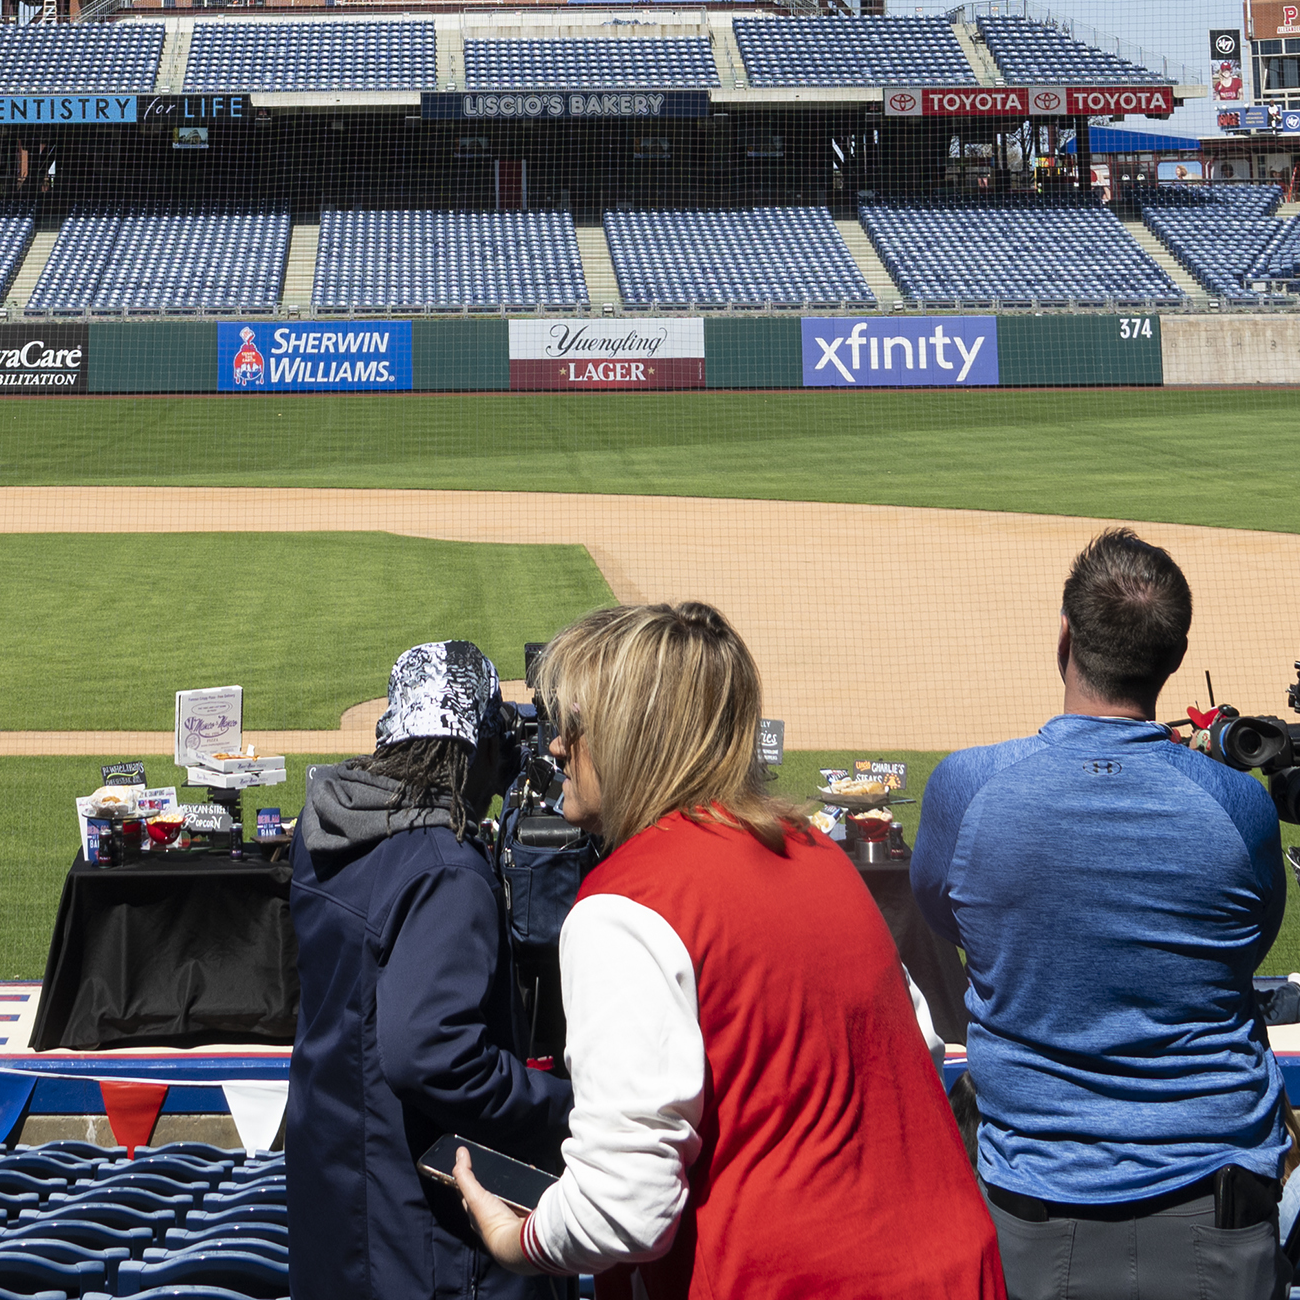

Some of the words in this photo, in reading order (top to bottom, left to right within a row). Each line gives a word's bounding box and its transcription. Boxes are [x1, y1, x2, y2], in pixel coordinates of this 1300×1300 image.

[143, 97, 175, 120] for
[184, 97, 242, 118] LIFE
[463, 95, 565, 116] LISCIO'S
[569, 94, 664, 116] BAKERY
[929, 93, 1022, 110] TOYOTA
[1073, 92, 1167, 109] TOYOTA
[1119, 318, 1152, 338] 374
[271, 328, 389, 355] SHERWIN
[546, 324, 667, 357] Yuengling
[814, 323, 984, 381] xfinity
[568, 362, 646, 381] LAGER
[871, 763, 904, 775] CHARLIE'S
